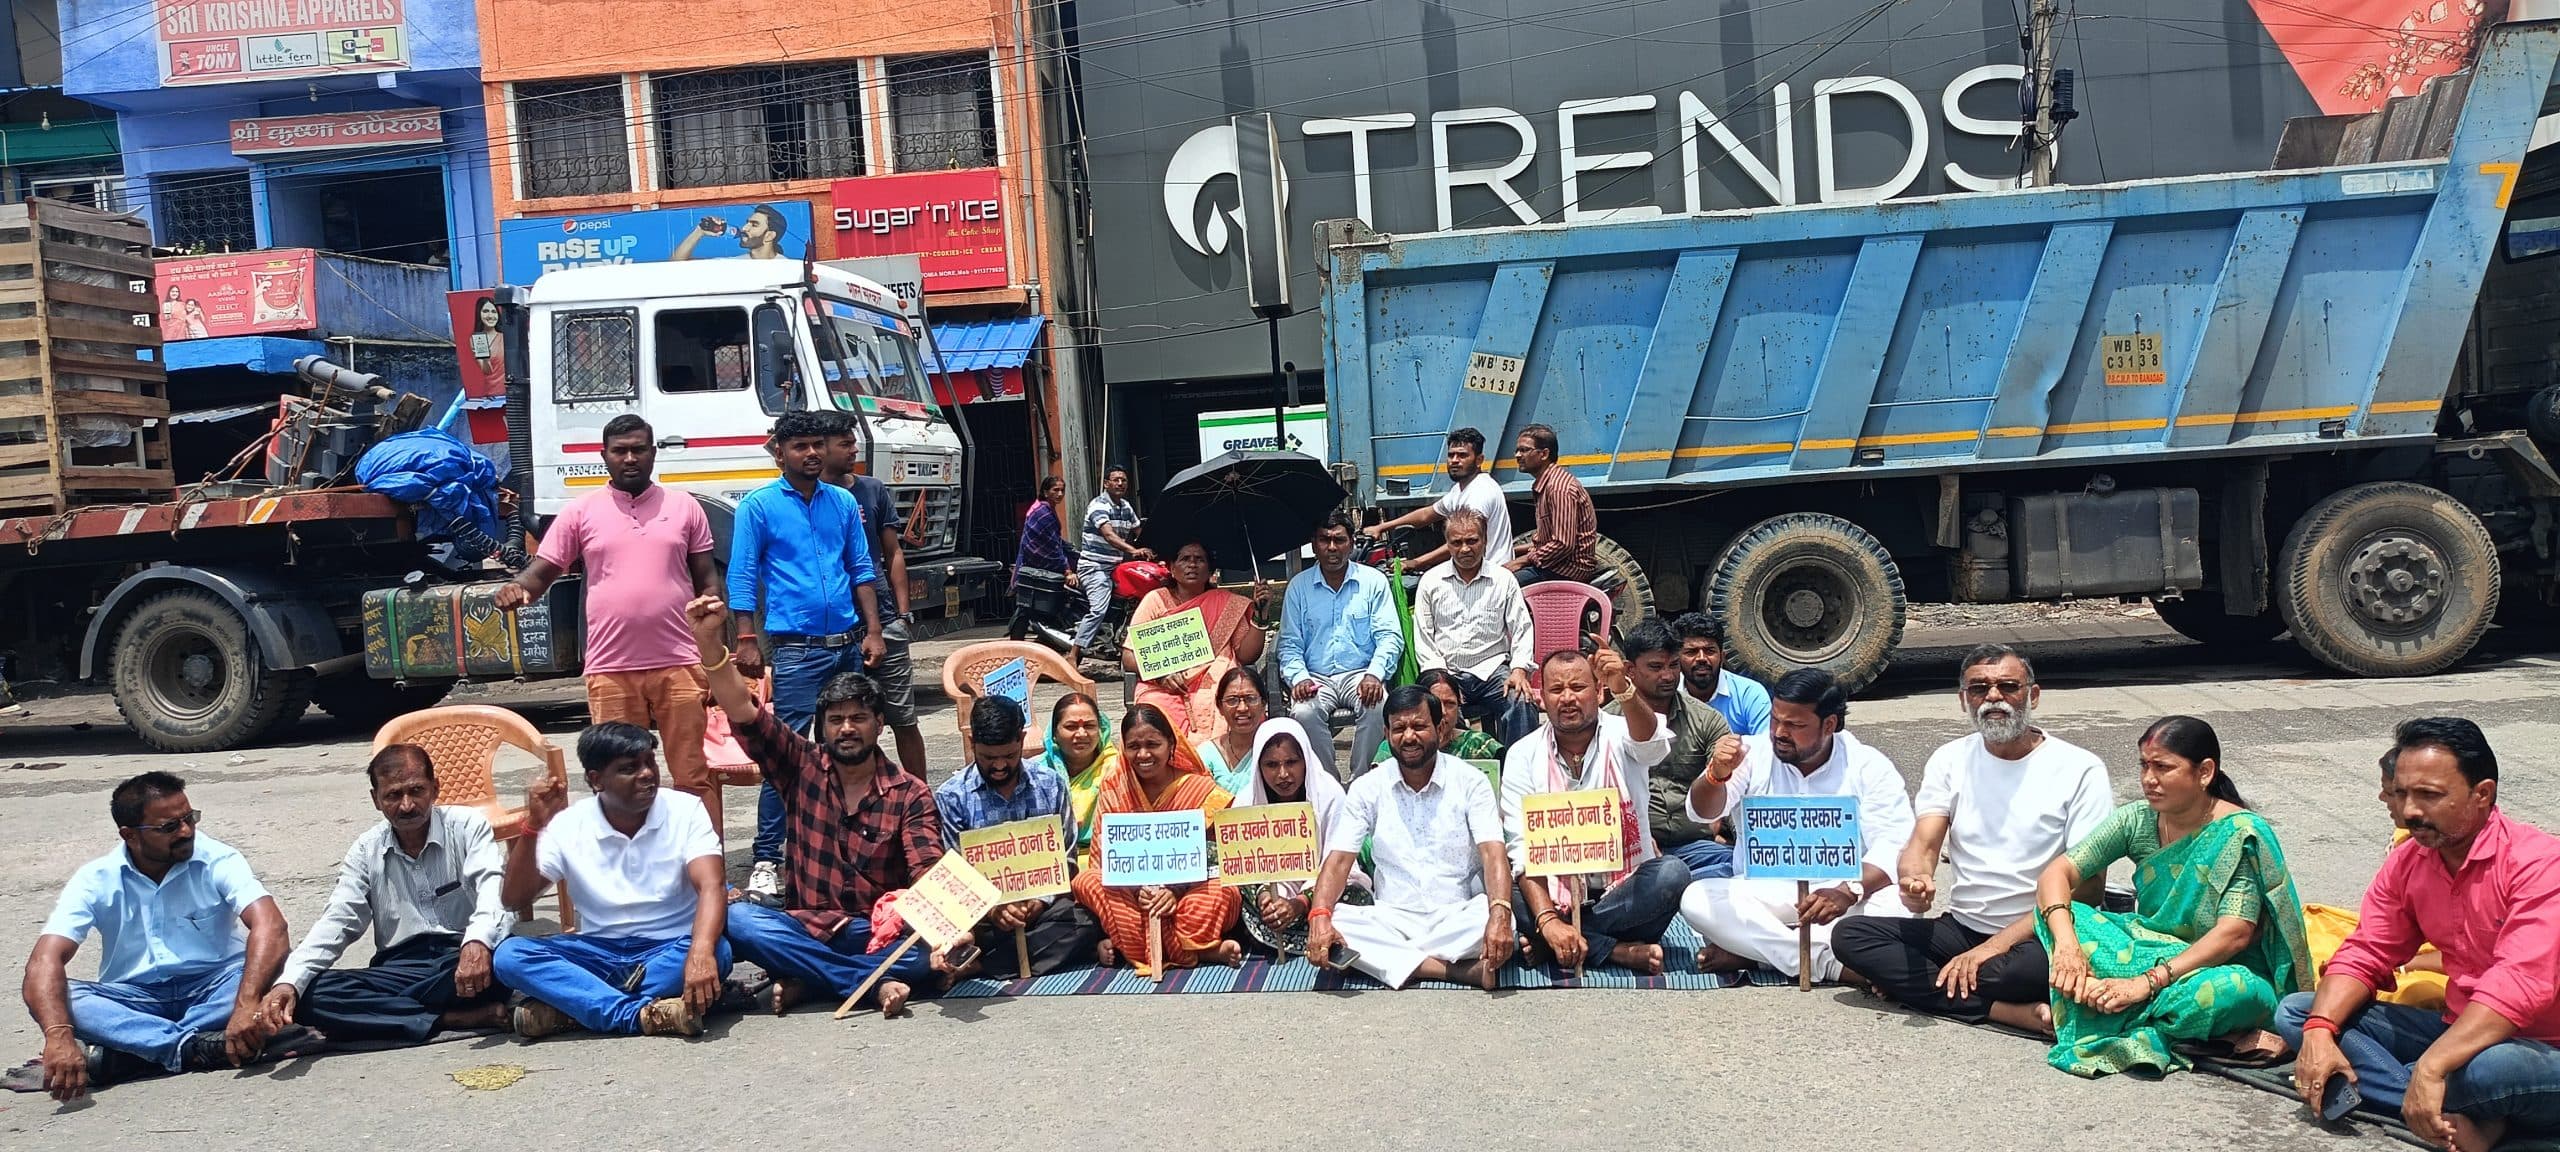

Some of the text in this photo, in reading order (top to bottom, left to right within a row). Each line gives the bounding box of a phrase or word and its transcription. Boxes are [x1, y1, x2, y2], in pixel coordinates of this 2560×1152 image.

[167, 0, 395, 35] SRI KRISHNA APPARELS
[205, 43, 229, 53] UNCLE
[256, 54, 285, 64] little
[288, 52, 313, 63] fern
[234, 122, 261, 142] श्री
[266, 122, 336, 146] कृष्णा
[1302, 65, 2058, 231] TRENDS
[580, 219, 611, 232] pepsi
[604, 236, 638, 256] UP
[2114, 339, 2153, 352] WB 53
[1477, 354, 1515, 372] WB 53
[1223, 437, 1280, 450] GREAVES
[1136, 624, 1166, 639] झारखण्ड
[1166, 617, 1190, 631] सरकार
[1139, 647, 1151, 660] सुन
[1152, 641, 1162, 653] लो
[1163, 635, 1182, 651] हमारी
[1143, 661, 1161, 673] जिला
[1162, 656, 1170, 667] दो
[1171, 656, 1179, 665] या
[1180, 649, 1195, 662] जेल
[1526, 810, 1544, 832] हम
[1576, 806, 1600, 826] ठाना
[1746, 808, 1797, 831] झारखण्ड
[1800, 808, 1842, 828] सरकार
[1107, 824, 1151, 844] झारखण्ड
[1154, 821, 1190, 839] सरकार
[1219, 823, 1239, 844] हम
[1272, 819, 1296, 838] ठाना
[965, 844, 985, 867] हम
[1018, 834, 1043, 855] ठाना
[1107, 846, 1201, 873] जिला दो या जेल दो
[1244, 849, 1256, 874] को
[1257, 847, 1279, 874] जिला
[1549, 838, 1560, 863] को
[1562, 835, 1581, 863] जिला
[1748, 837, 1856, 867] जिला दो या जेल दो
[1004, 866, 1027, 893] जिला
